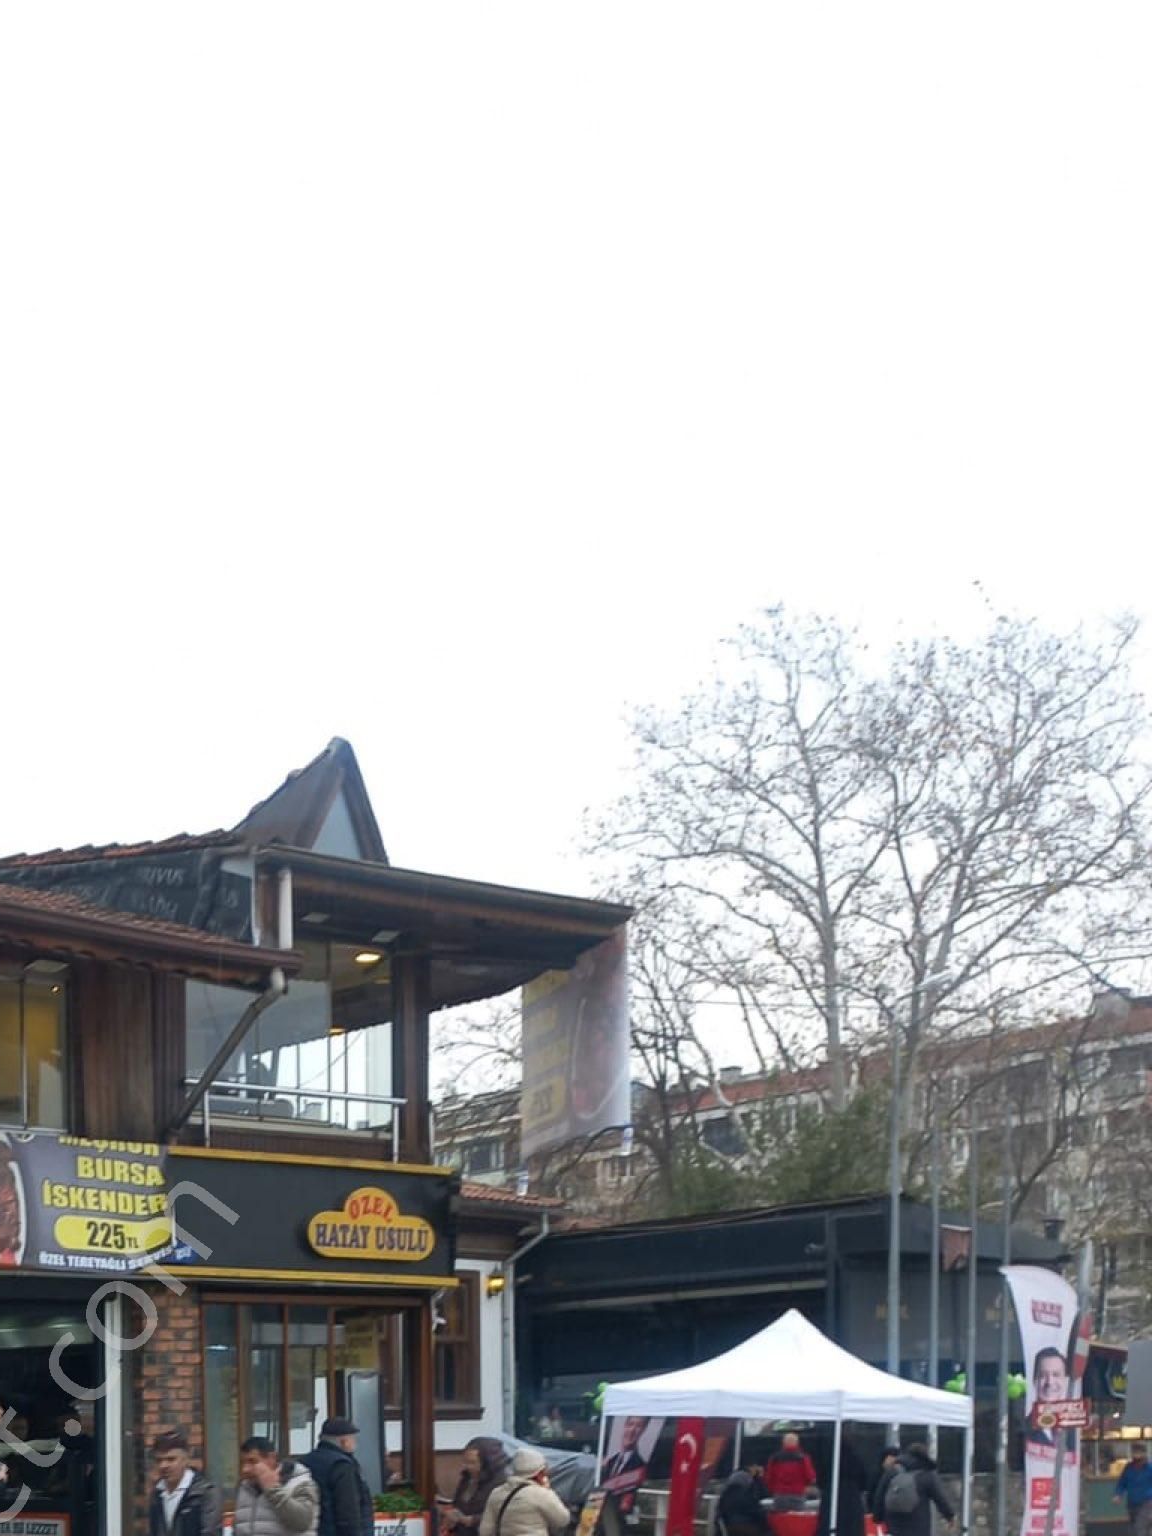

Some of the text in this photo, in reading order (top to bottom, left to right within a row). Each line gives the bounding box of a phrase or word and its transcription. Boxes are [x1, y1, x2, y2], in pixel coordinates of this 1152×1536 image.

[77, 1155, 165, 1186] BURSA
[42, 1179, 168, 1216] İSKENDER
[315, 1223, 370, 1249] HATAY
